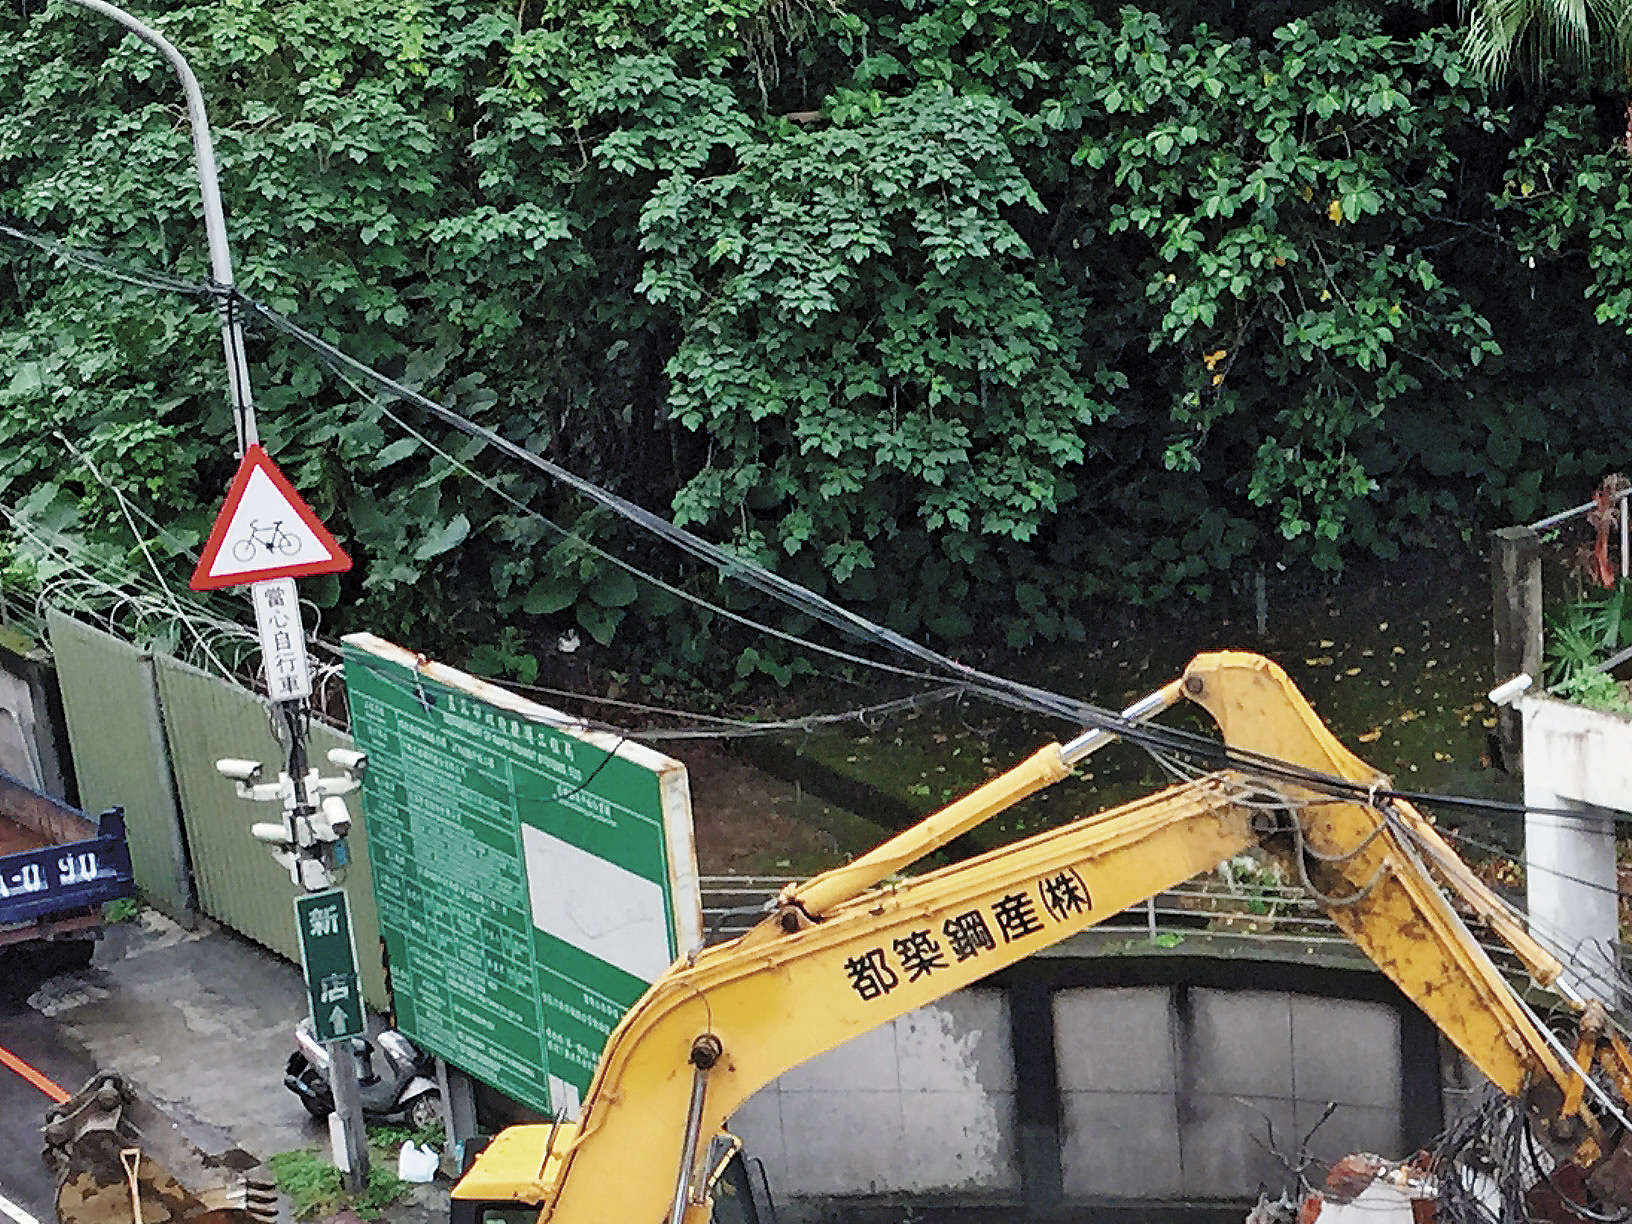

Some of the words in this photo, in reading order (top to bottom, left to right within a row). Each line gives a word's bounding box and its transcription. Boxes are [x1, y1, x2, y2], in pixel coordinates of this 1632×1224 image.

[264, 586, 300, 695] 當心自行車
[307, 904, 351, 1004] 新店
